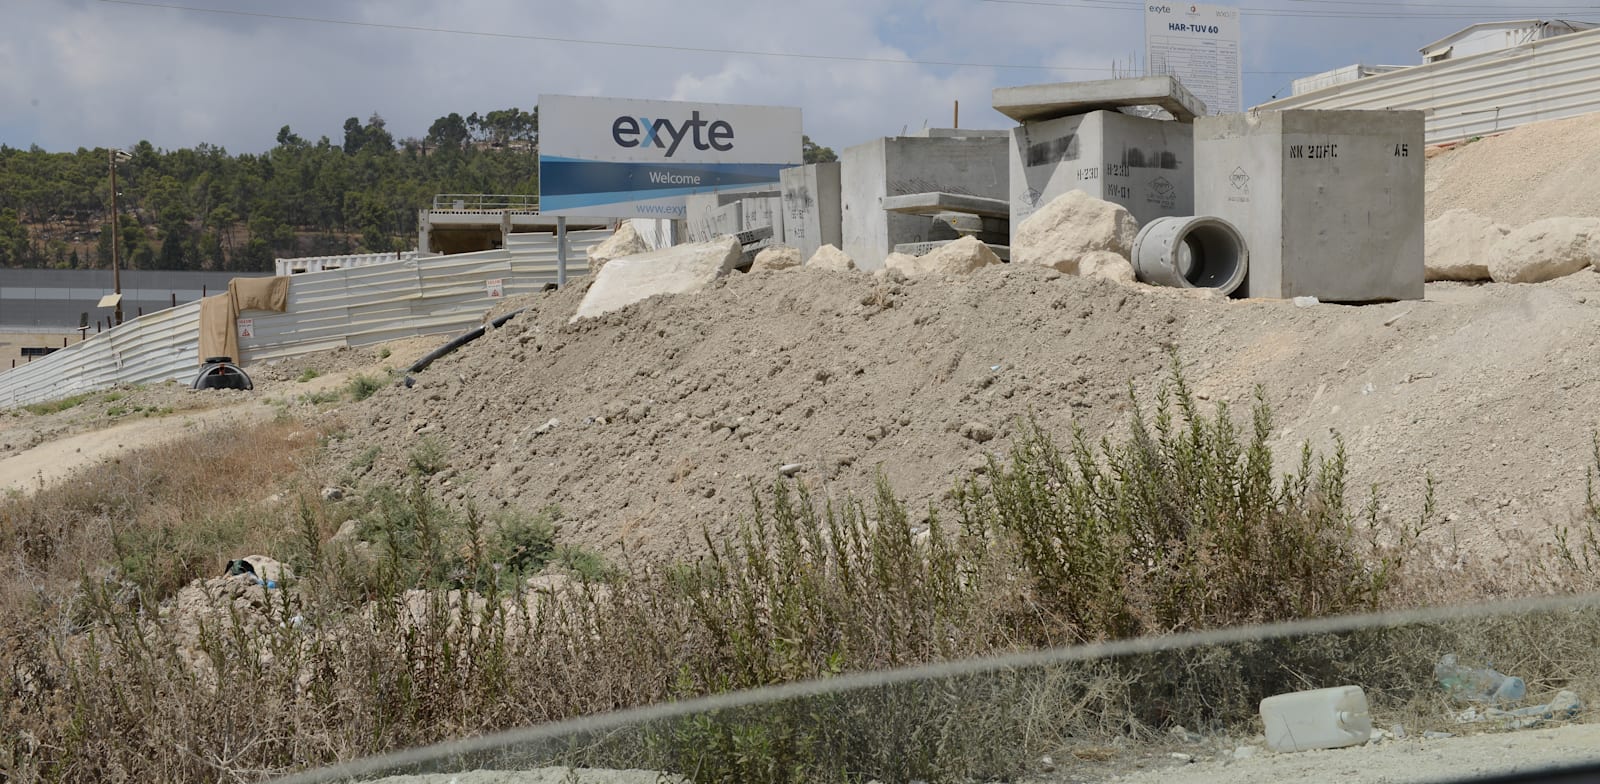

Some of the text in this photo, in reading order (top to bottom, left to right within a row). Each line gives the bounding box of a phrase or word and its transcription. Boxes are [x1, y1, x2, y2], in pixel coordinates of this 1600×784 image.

[1149, 5, 1171, 14] exyte
[1168, 22, 1219, 34] HAR-TUV 60
[612, 111, 735, 158] exyte
[650, 171, 701, 185] Welcome
